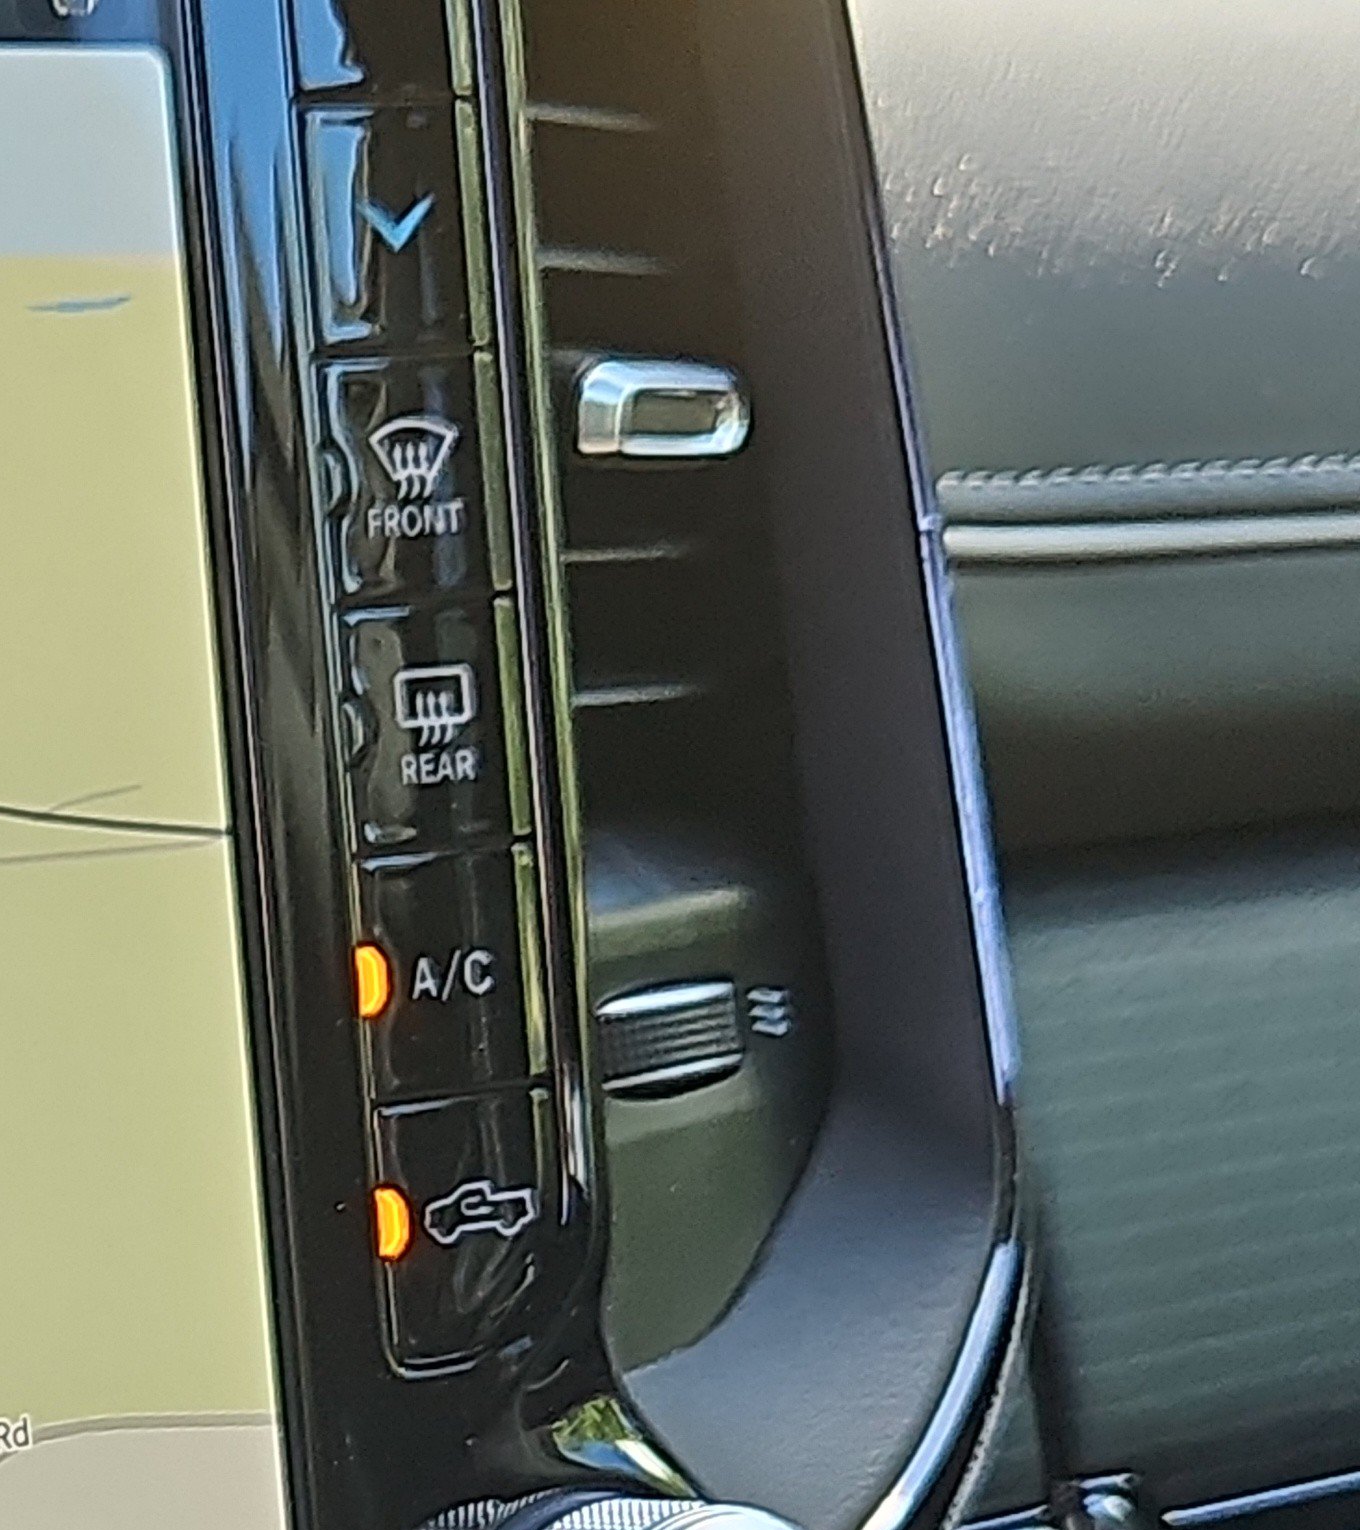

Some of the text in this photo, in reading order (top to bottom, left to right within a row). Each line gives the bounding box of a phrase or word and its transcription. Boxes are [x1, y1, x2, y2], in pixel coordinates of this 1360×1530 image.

[368, 499, 464, 537] FRONT
[402, 751, 476, 785] REAR
[411, 949, 493, 1000] A/C
